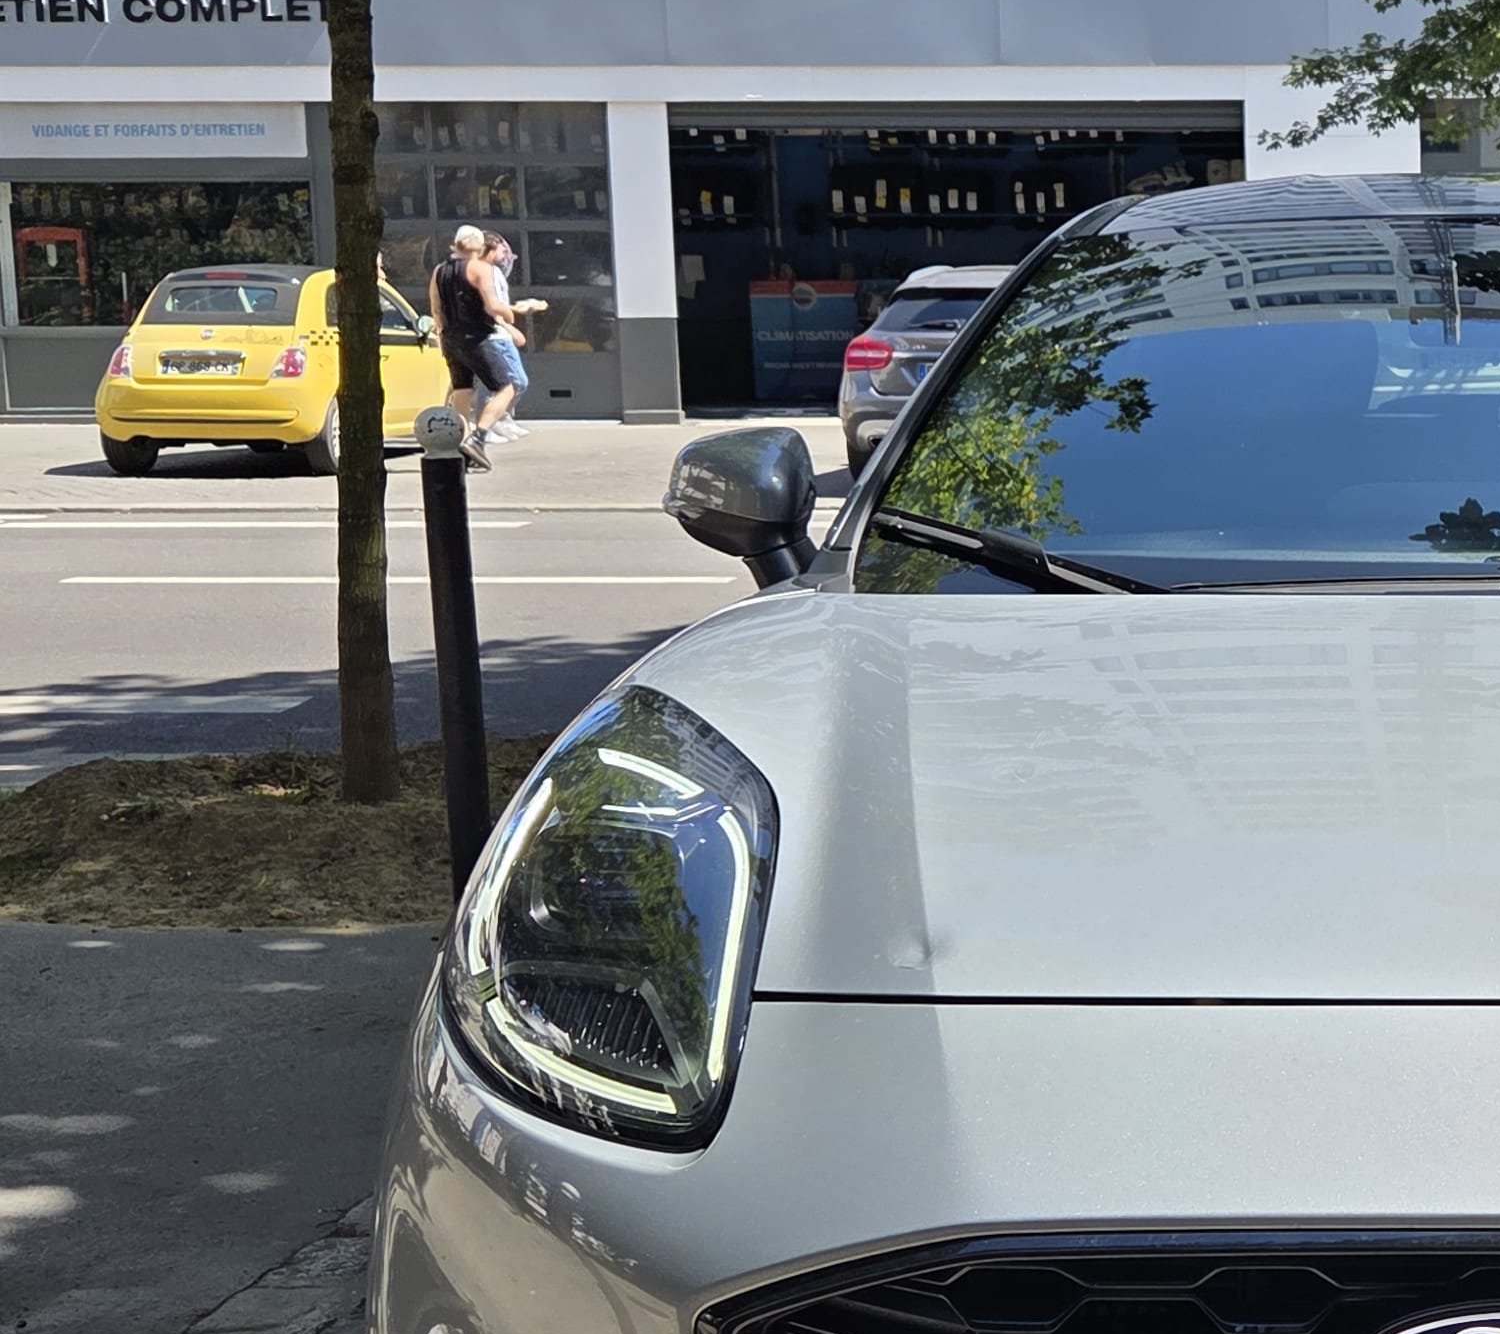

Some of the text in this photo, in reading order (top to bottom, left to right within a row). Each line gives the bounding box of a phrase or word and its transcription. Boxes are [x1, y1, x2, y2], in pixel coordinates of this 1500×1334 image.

[31, 122, 266, 138] VIDANGE ET FORFAITS D'ENTRETIEN
